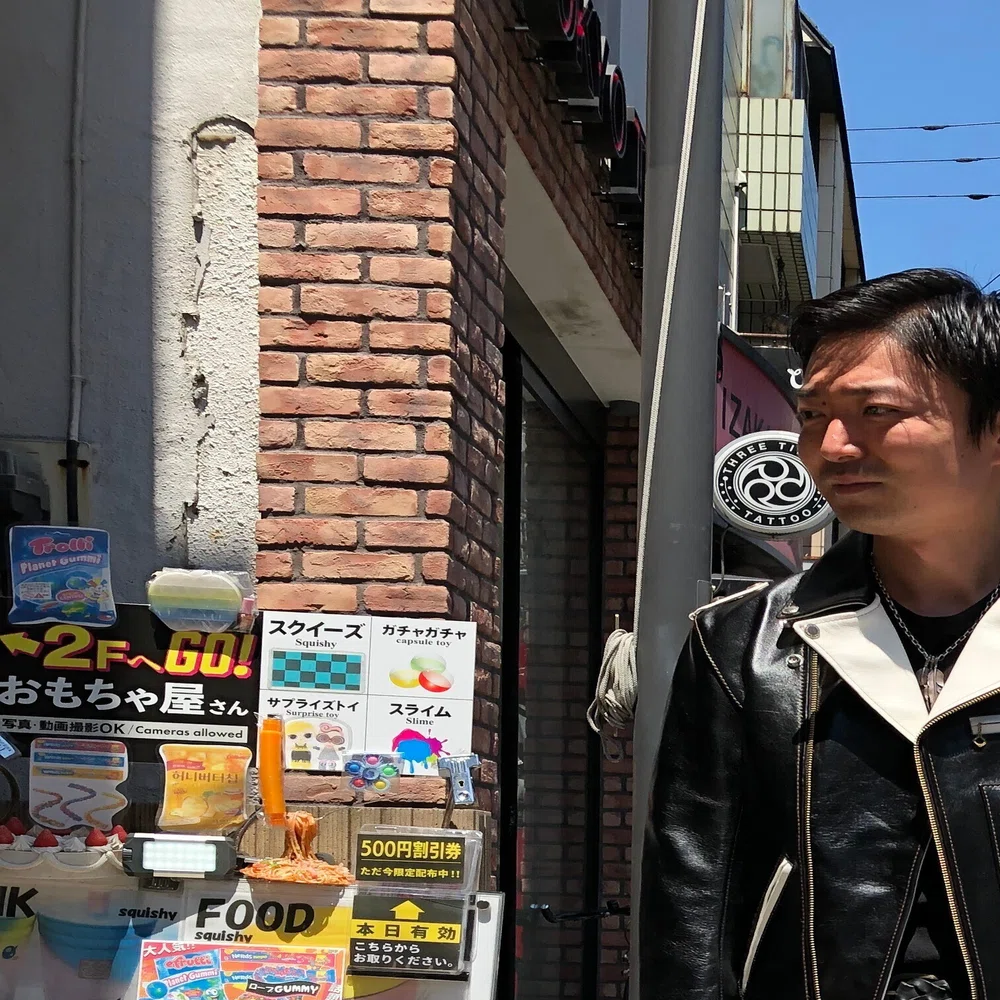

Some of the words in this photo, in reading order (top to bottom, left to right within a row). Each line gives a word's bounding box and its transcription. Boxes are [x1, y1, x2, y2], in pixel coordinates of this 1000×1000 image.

[723, 443, 768, 474] THREE
[778, 442, 799, 454] TI
[744, 509, 812, 525] TATTOO
[28, 536, 95, 555] Trolli
[20, 559, 57, 574] Planet
[60, 555, 102, 566] Gummi
[269, 620, 366, 639] スクイーズ
[382, 624, 467, 640] ガチャガチャ
[295, 638, 338, 649] Squishy
[396, 638, 433, 646] capsule
[435, 639, 452, 647] toy
[0, 675, 249, 717] おもちゃ屋さん
[267, 697, 360, 712] サプライズトイ
[389, 702, 452, 718] スライム
[286, 709, 324, 718] Surprise
[325, 711, 340, 719] toy
[406, 717, 435, 726] Slime
[135, 725, 190, 737] Cameras
[193, 727, 244, 739] allowed
[360, 840, 462, 860] 500円割引券
[0, 886, 39, 918] K
[118, 907, 177, 921] squishy
[196, 898, 315, 933] FOOD
[194, 930, 253, 943] squishy
[356, 922, 457, 940] 本日有効
[354, 942, 420, 954] こちらから
[353, 954, 453, 967] お取りください。
[189, 969, 219, 980] Gummi
